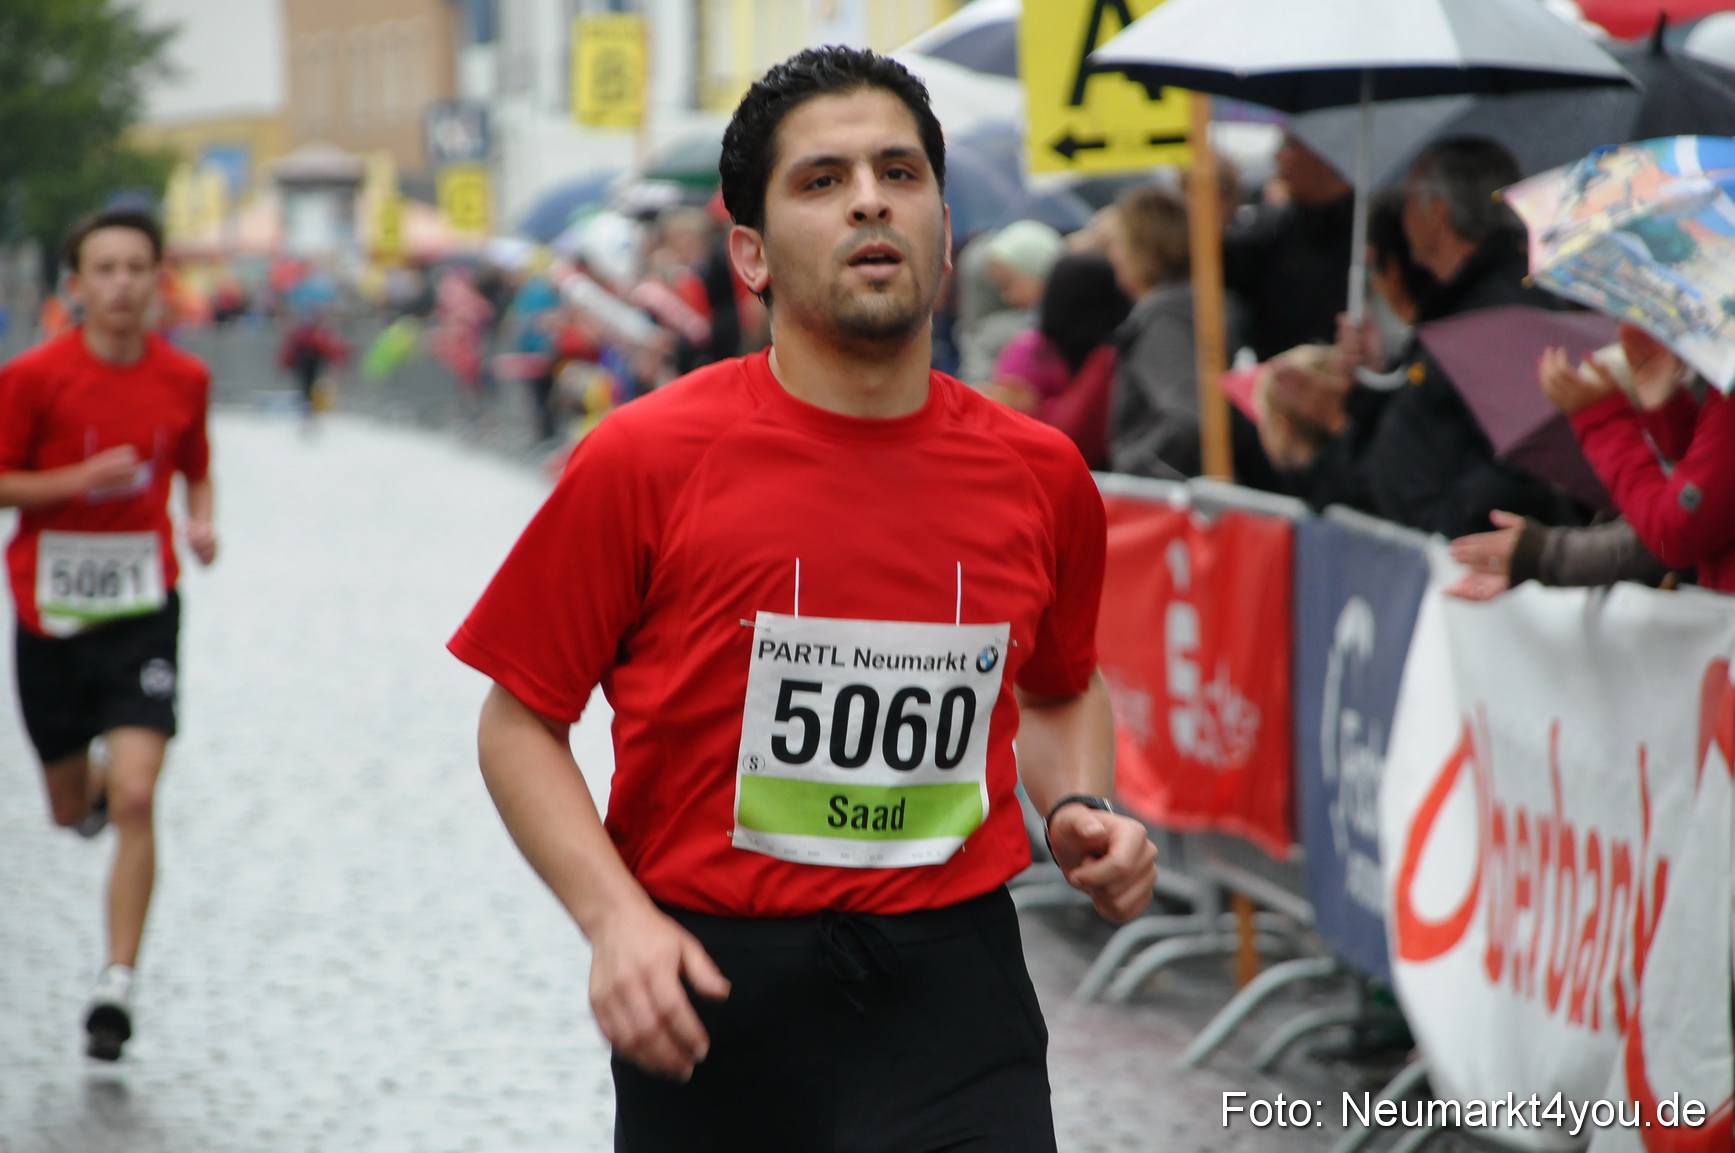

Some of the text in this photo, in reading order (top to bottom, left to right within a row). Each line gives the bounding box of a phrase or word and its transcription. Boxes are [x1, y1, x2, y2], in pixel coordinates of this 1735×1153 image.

[757, 639, 968, 673] PARTL Neumarkt
[770, 678, 977, 772] 5060
[827, 794, 906, 831] Saad
